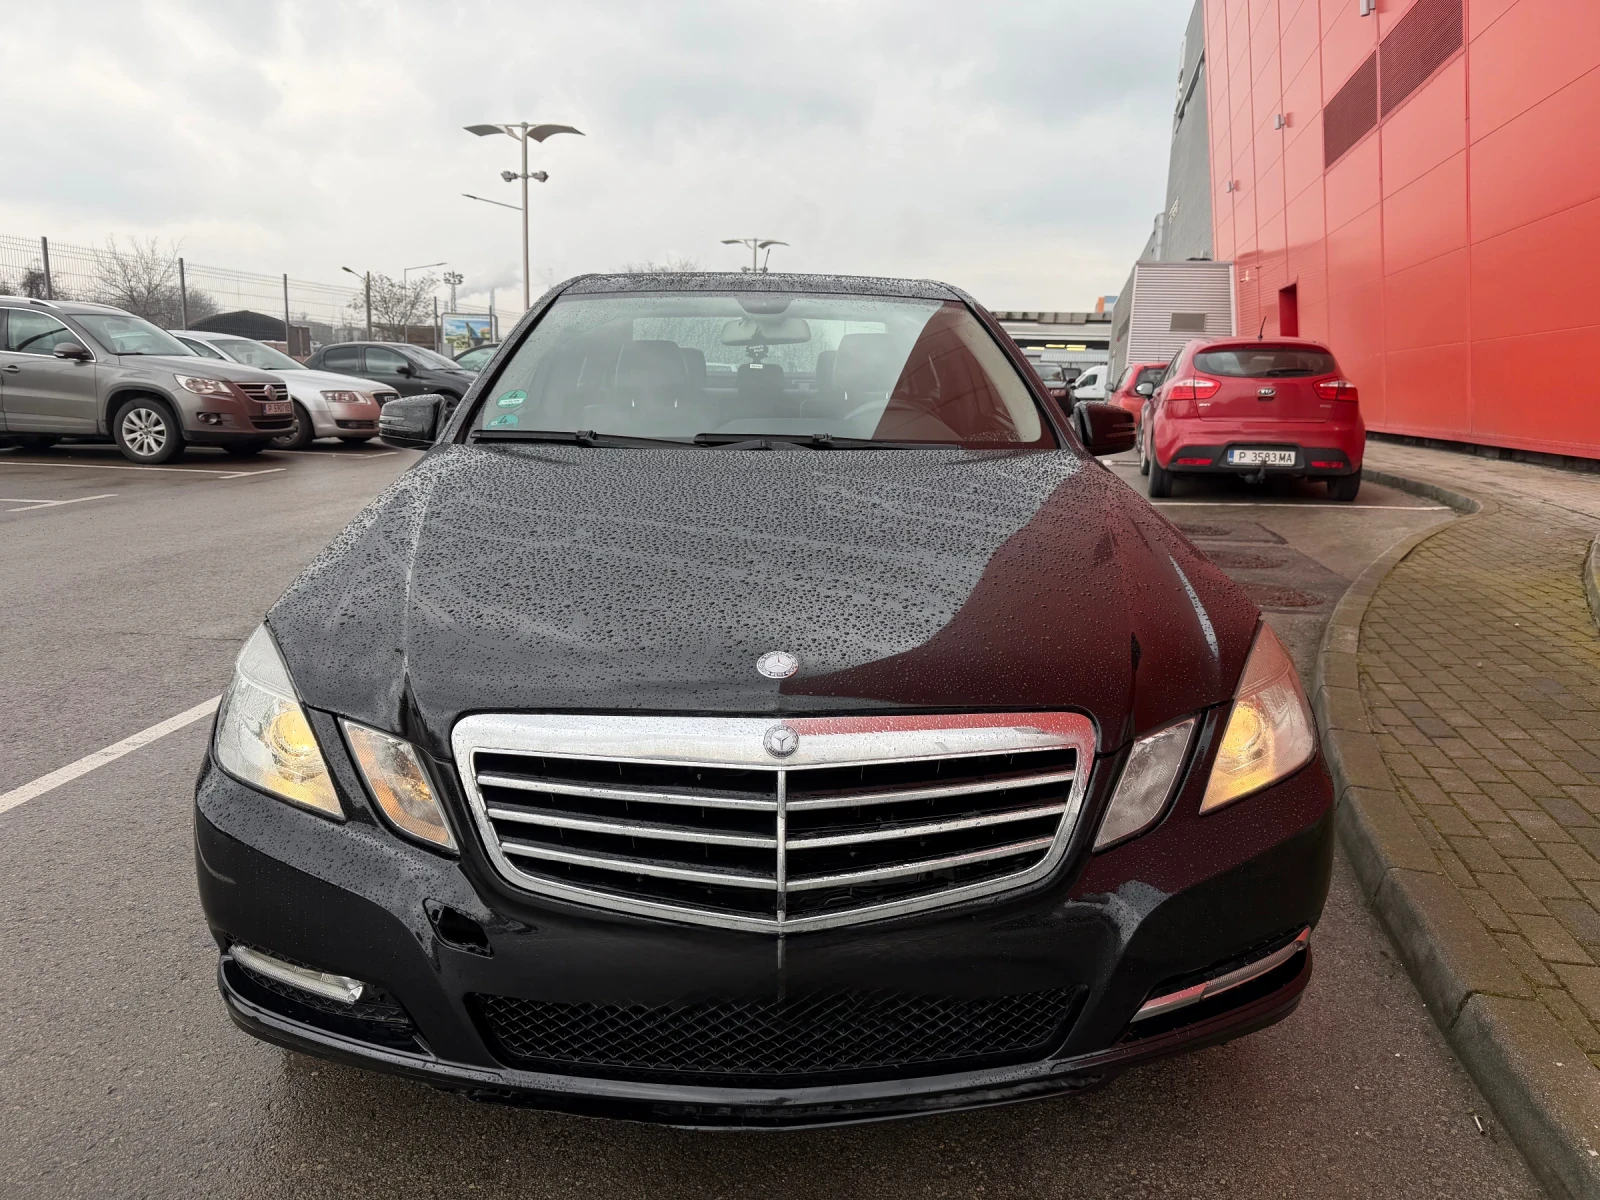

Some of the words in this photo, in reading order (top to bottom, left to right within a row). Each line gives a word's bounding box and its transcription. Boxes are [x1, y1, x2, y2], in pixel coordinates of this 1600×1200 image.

[509, 390, 518, 399] 4
[498, 415, 508, 424] 4
[1238, 451, 1246, 462] P
[1251, 451, 1277, 463] 3583
[1278, 452, 1293, 463] MA
